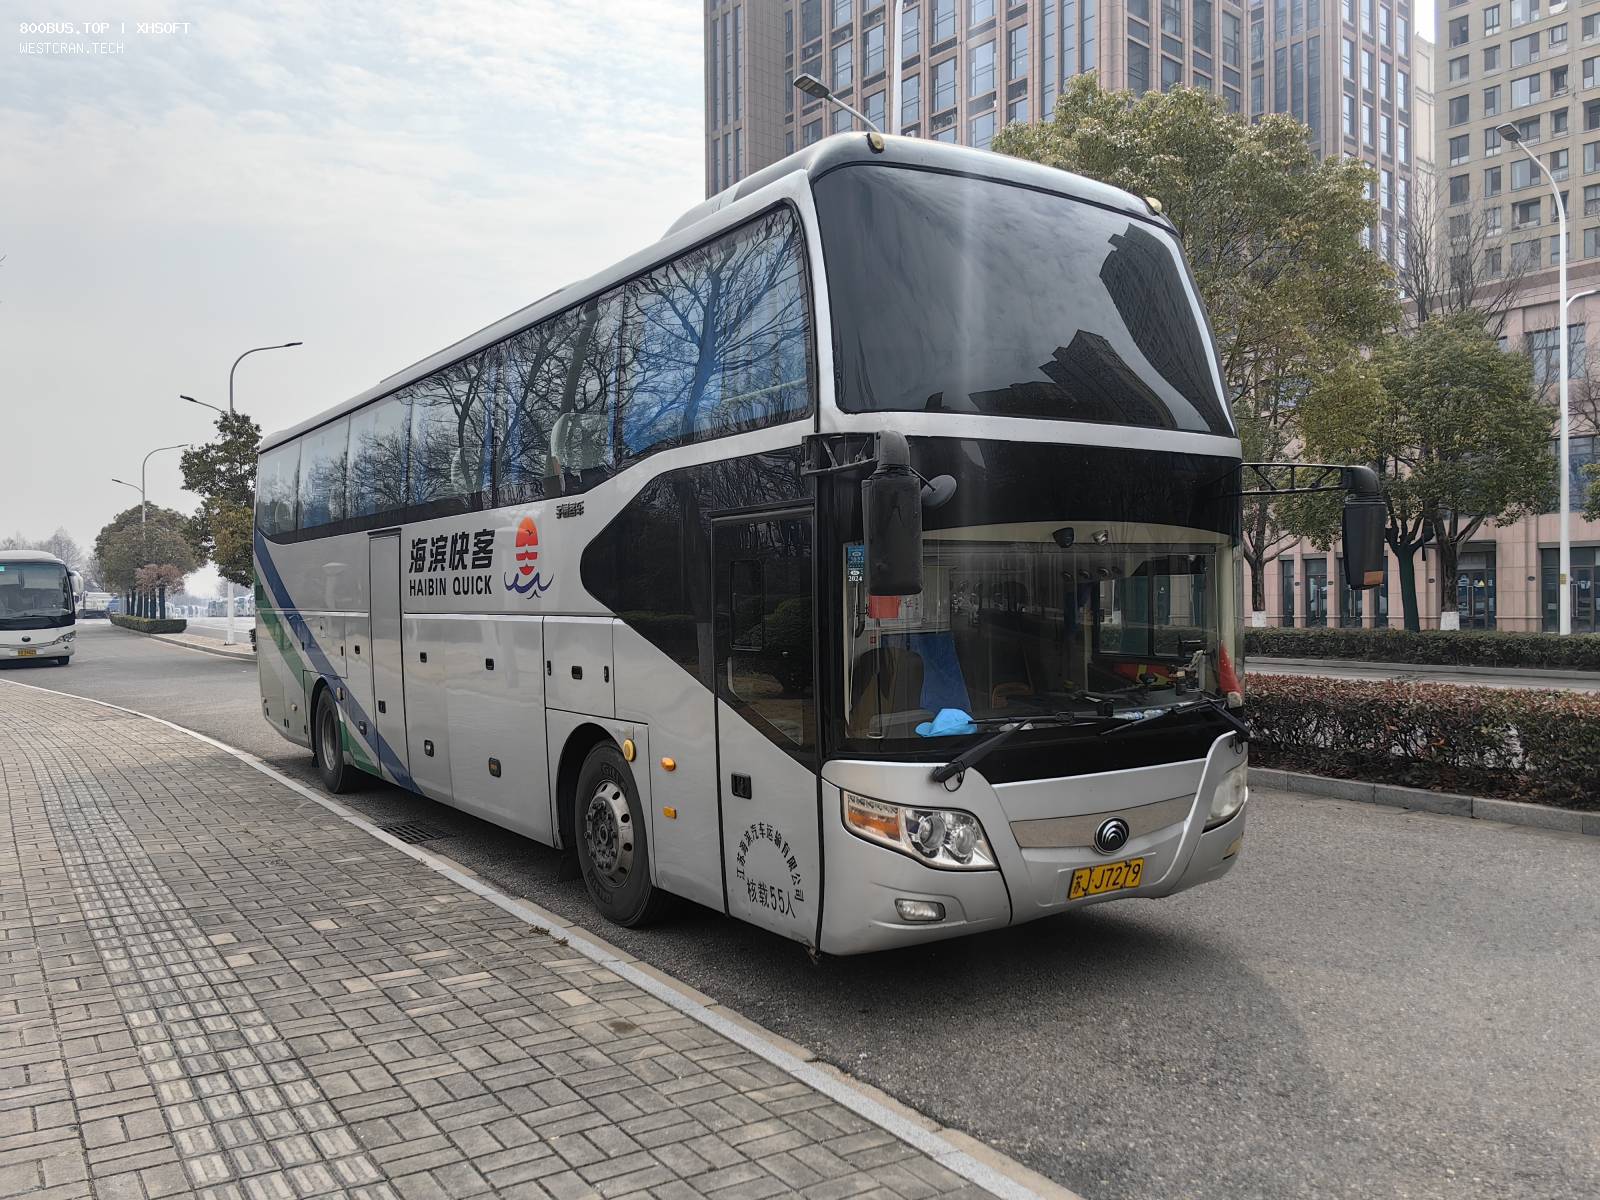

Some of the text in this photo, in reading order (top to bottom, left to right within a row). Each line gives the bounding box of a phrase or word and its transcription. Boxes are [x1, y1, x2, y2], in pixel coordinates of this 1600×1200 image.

[408, 528, 496, 574] 海滨快客
[409, 575, 493, 597] HAIBIN QUICK
[746, 878, 796, 919] 核载55人
